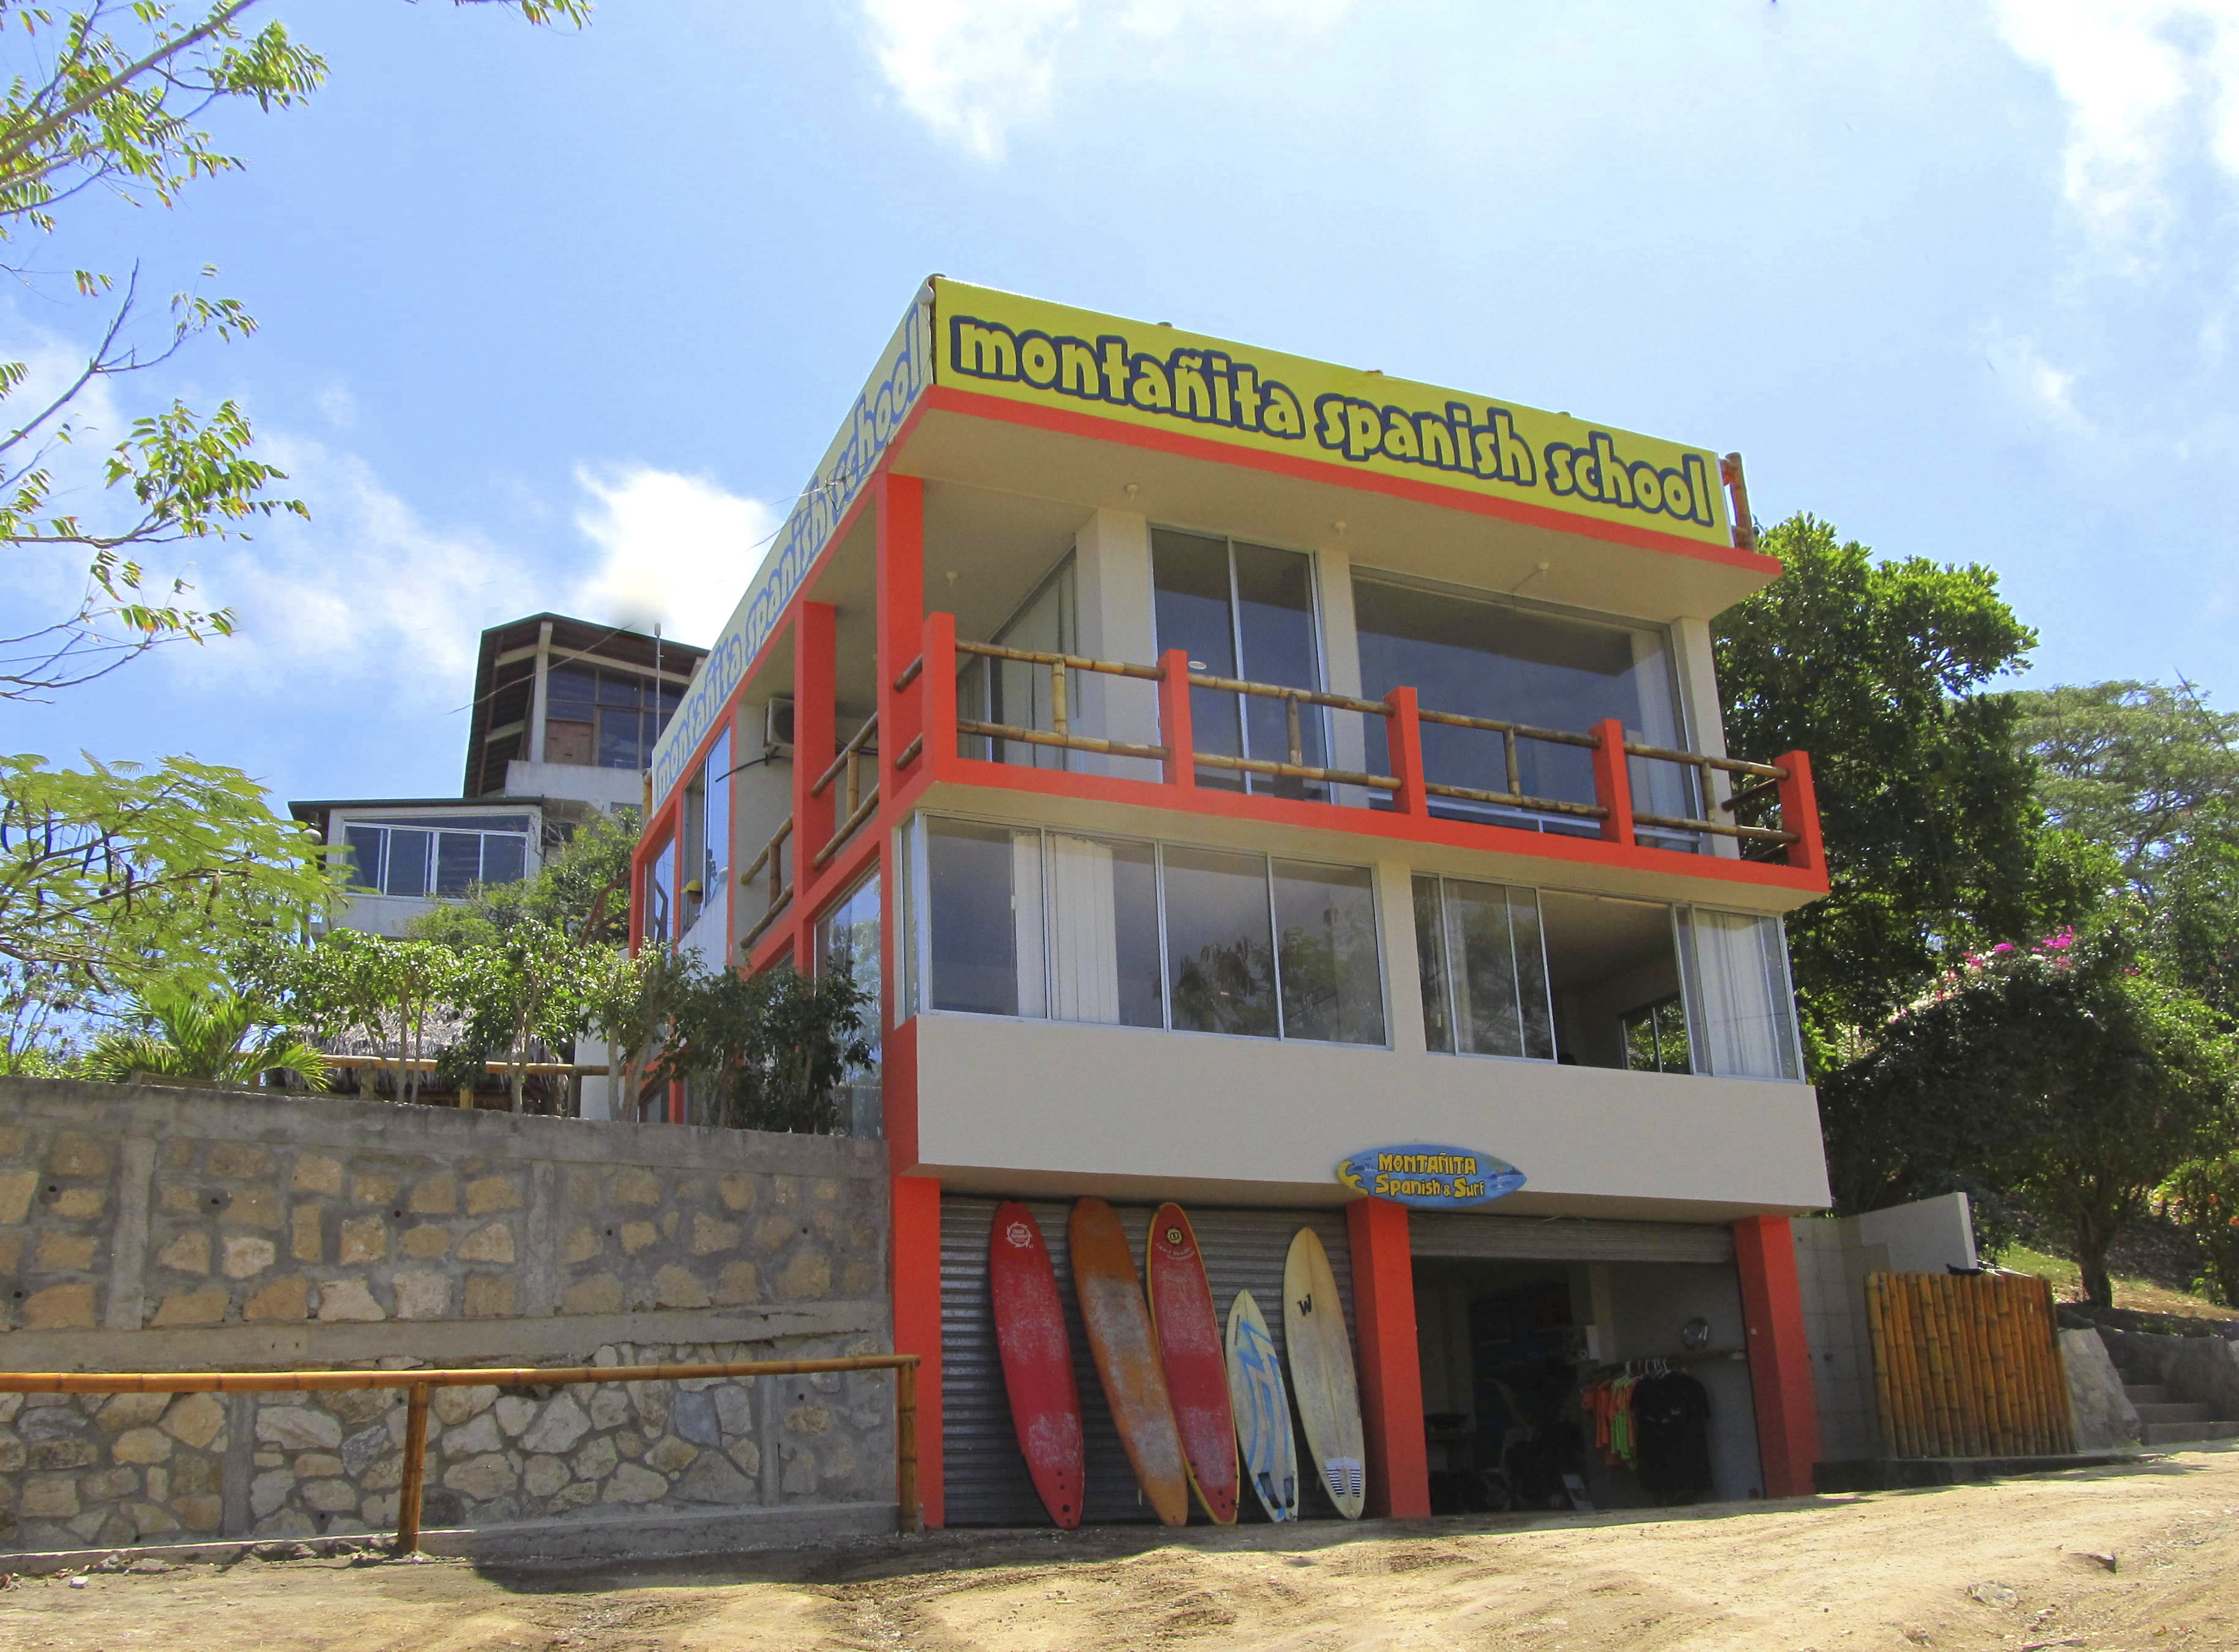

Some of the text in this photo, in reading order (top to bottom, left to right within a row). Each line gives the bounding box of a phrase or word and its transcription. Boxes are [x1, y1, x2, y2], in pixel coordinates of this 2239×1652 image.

[950, 315, 1714, 527] montañita spanish school
[656, 302, 921, 805] montañita spanish school
[1375, 1174, 1440, 1197] Spanish
[1443, 1185, 1452, 1197] &
[1378, 1152, 1477, 1175] MONTAÑITA
